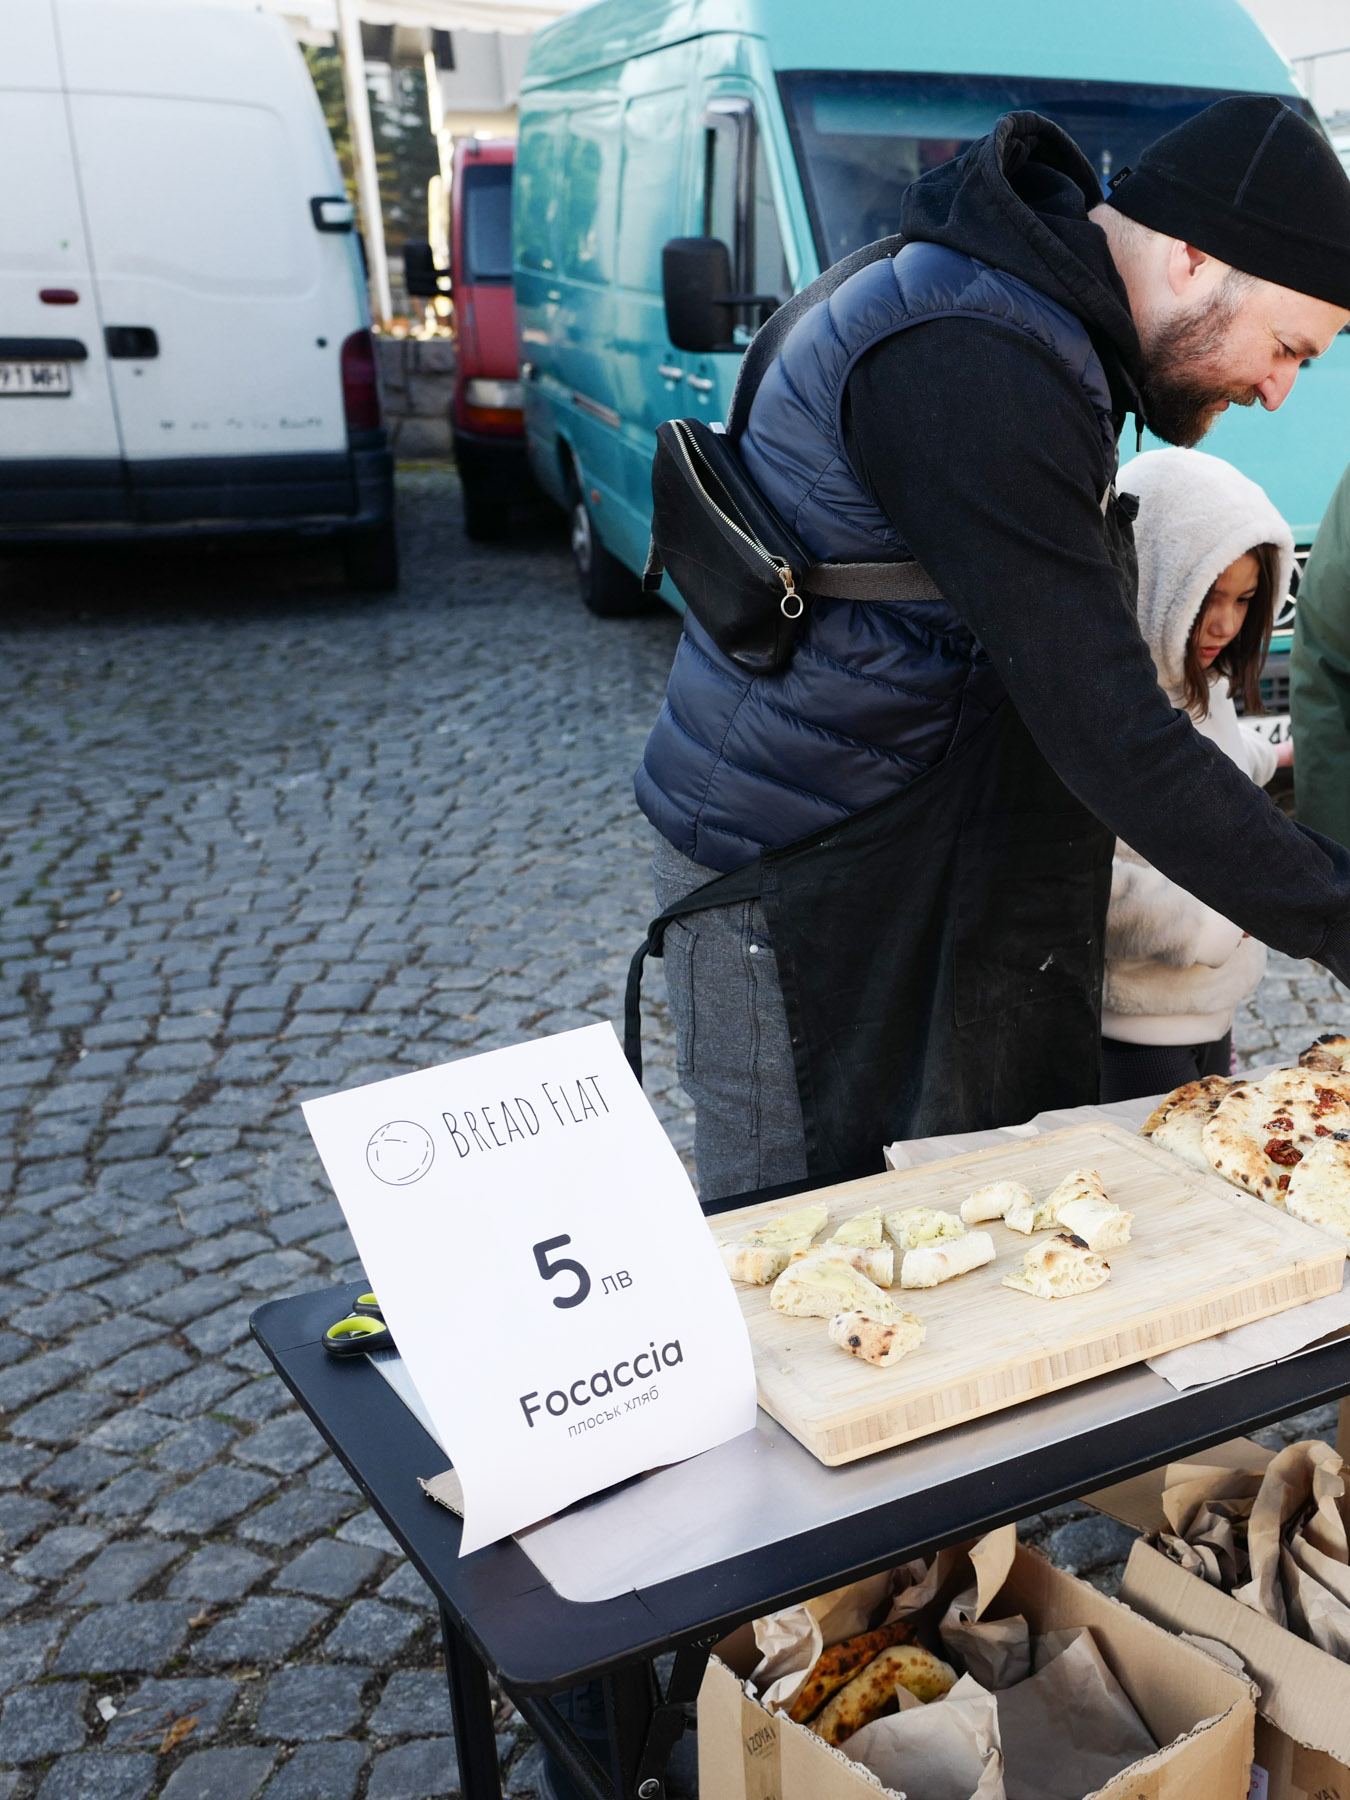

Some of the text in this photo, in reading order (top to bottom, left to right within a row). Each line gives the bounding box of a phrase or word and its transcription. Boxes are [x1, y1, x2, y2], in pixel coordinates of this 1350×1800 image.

[442, 1075, 610, 1158] BREAD FLAT
[533, 1234, 633, 1310] 5 лв
[519, 1339, 684, 1428] Focaccia
[568, 1385, 660, 1438] плосък хляб
[748, 1727, 773, 1752] ZOYA
